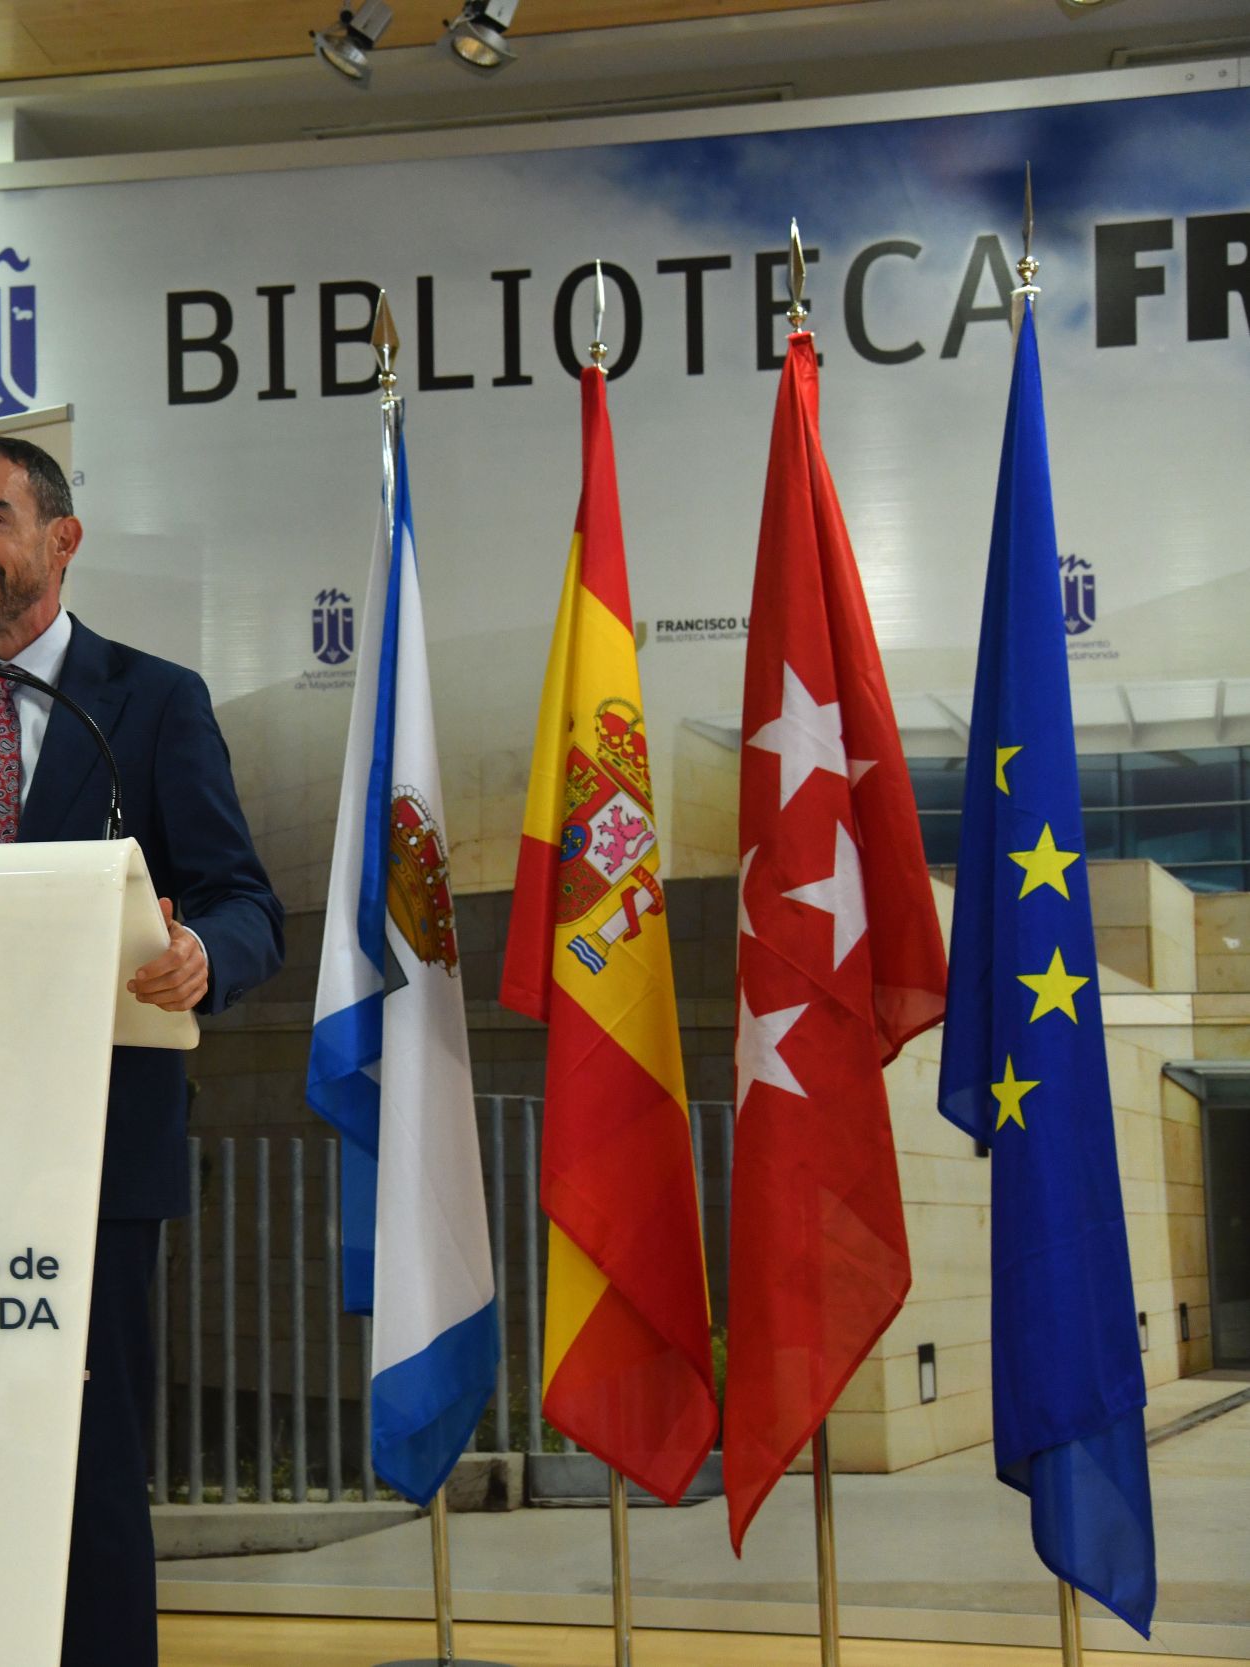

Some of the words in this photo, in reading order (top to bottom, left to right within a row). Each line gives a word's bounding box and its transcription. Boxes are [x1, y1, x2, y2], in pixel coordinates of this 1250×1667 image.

[167, 234, 1015, 406] BIBLIOTECA
[656, 618, 737, 632] FRANCISCO
[9, 1248, 60, 1281] de
